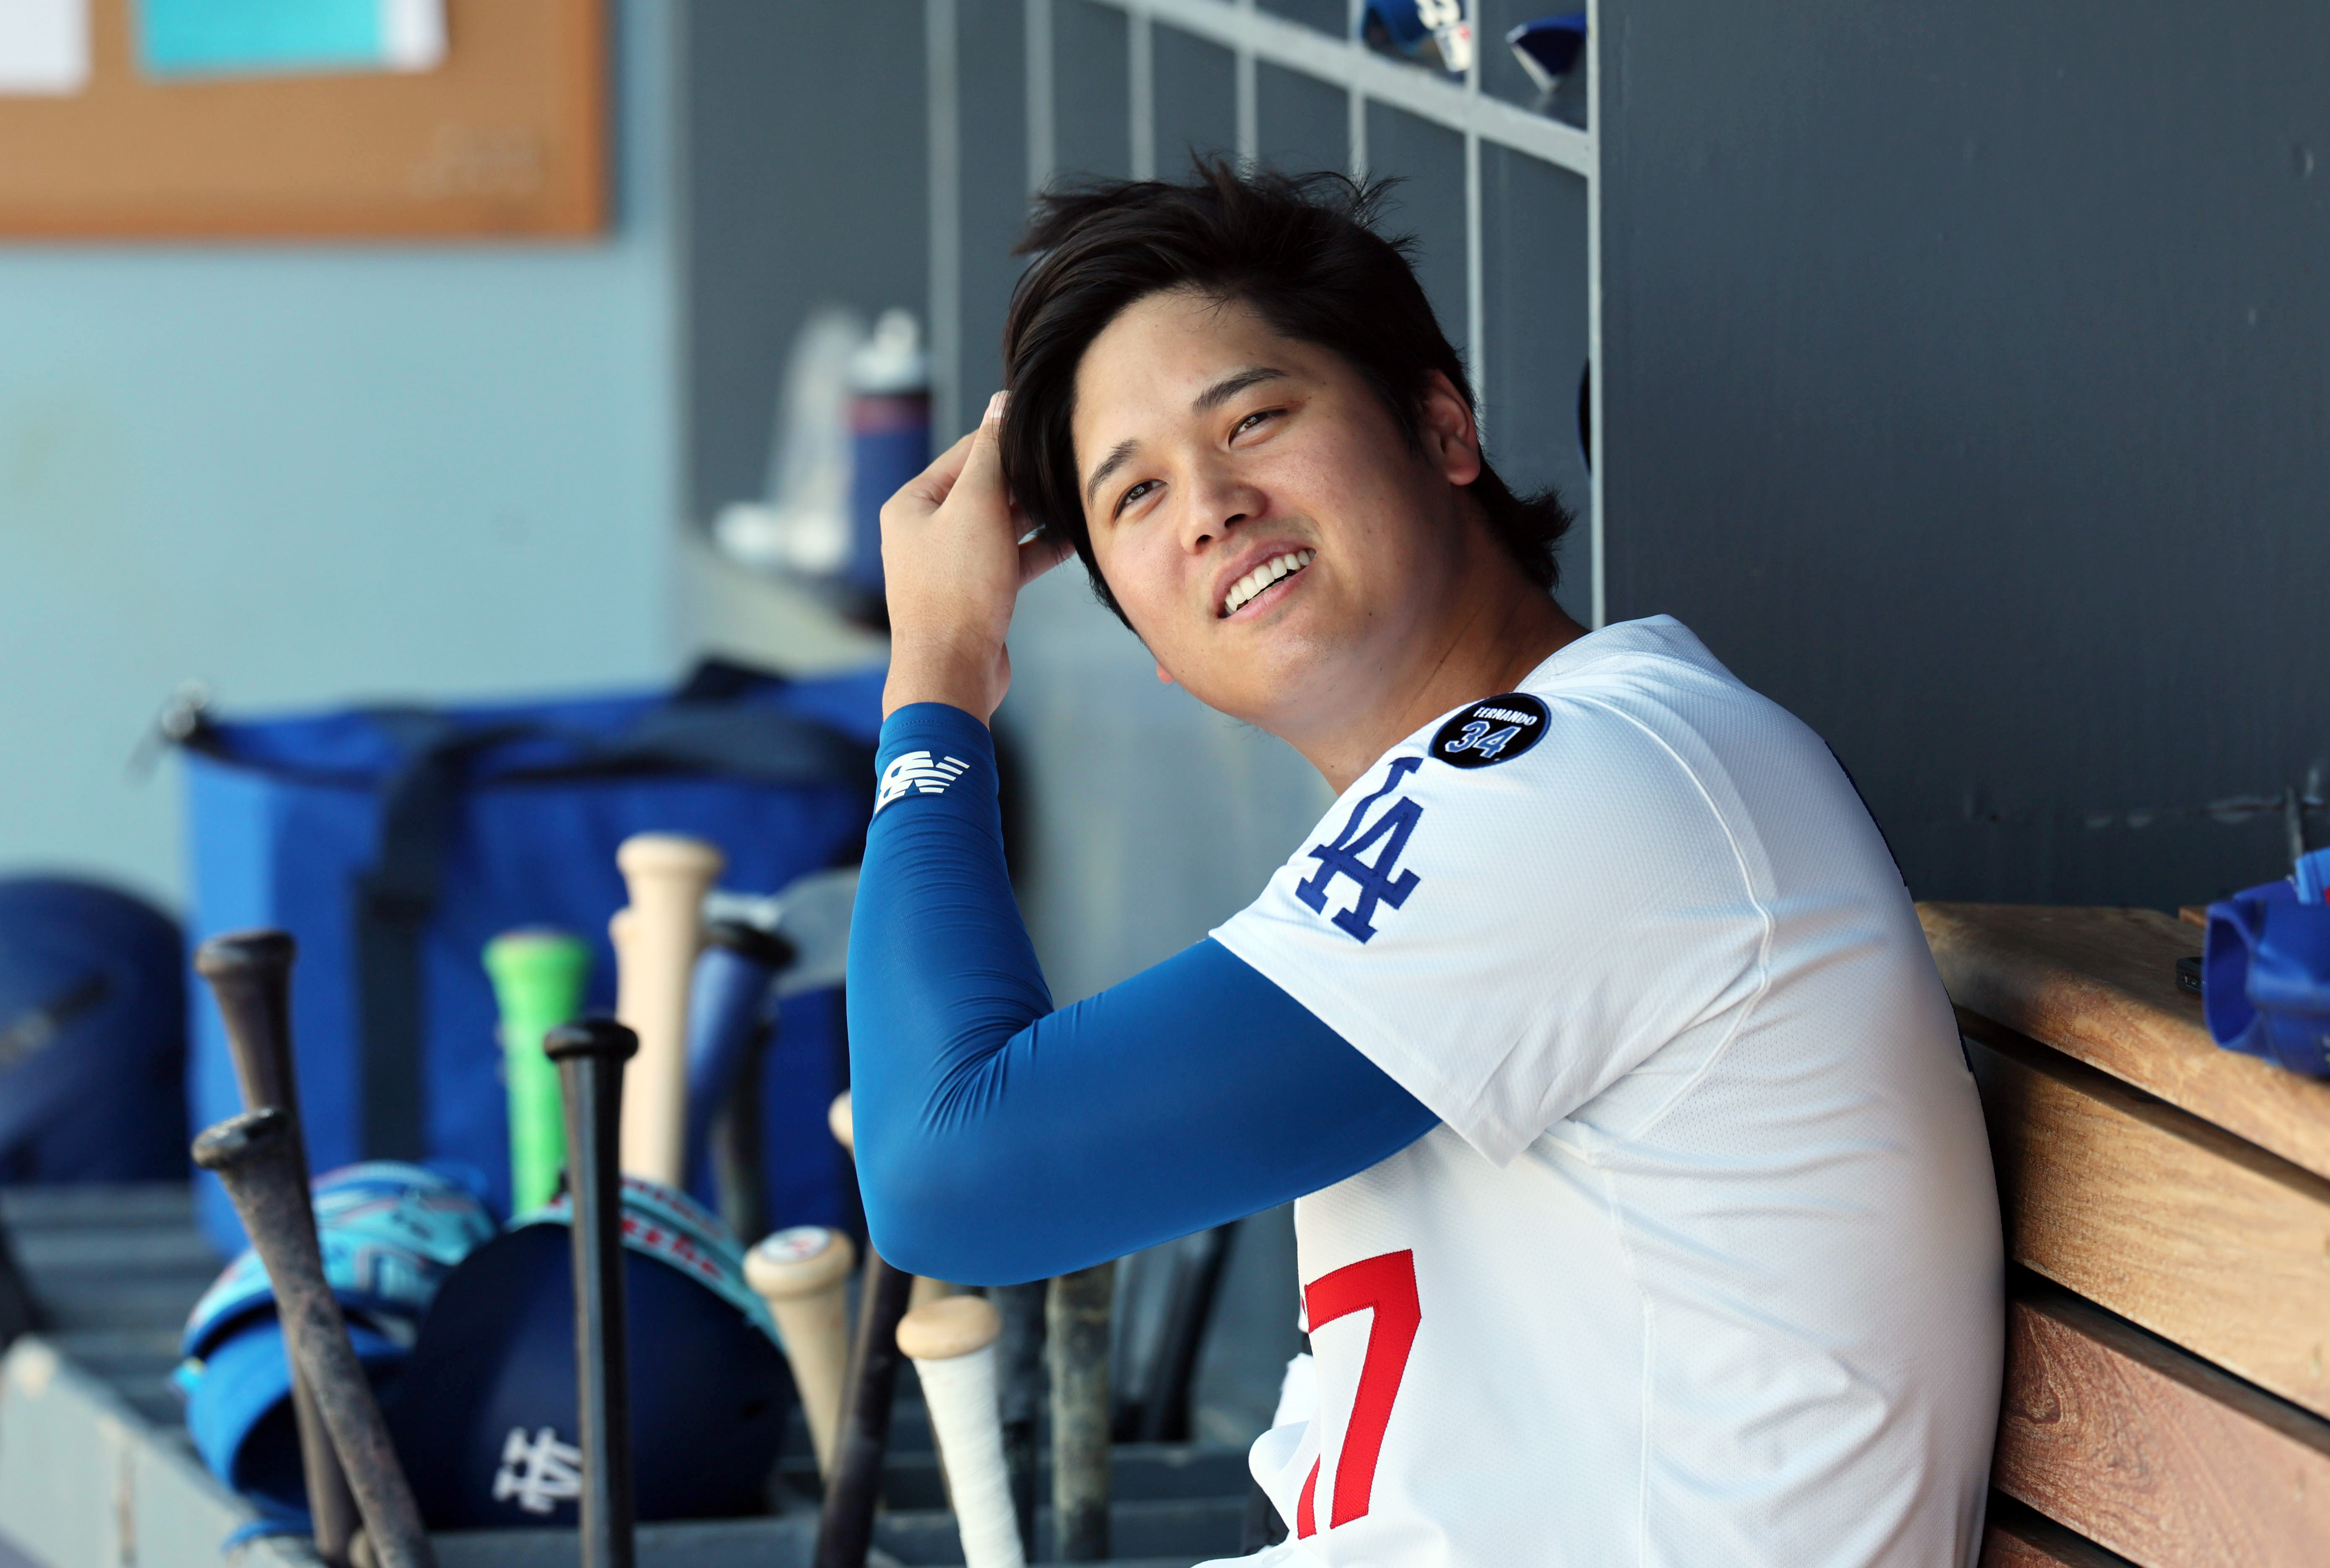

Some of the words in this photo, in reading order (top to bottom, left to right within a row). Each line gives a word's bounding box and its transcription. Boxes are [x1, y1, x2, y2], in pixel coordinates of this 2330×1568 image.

[1472, 706, 1538, 726] FERNANDO
[1444, 720, 1522, 758] 34
[1294, 756, 1425, 945] LA
